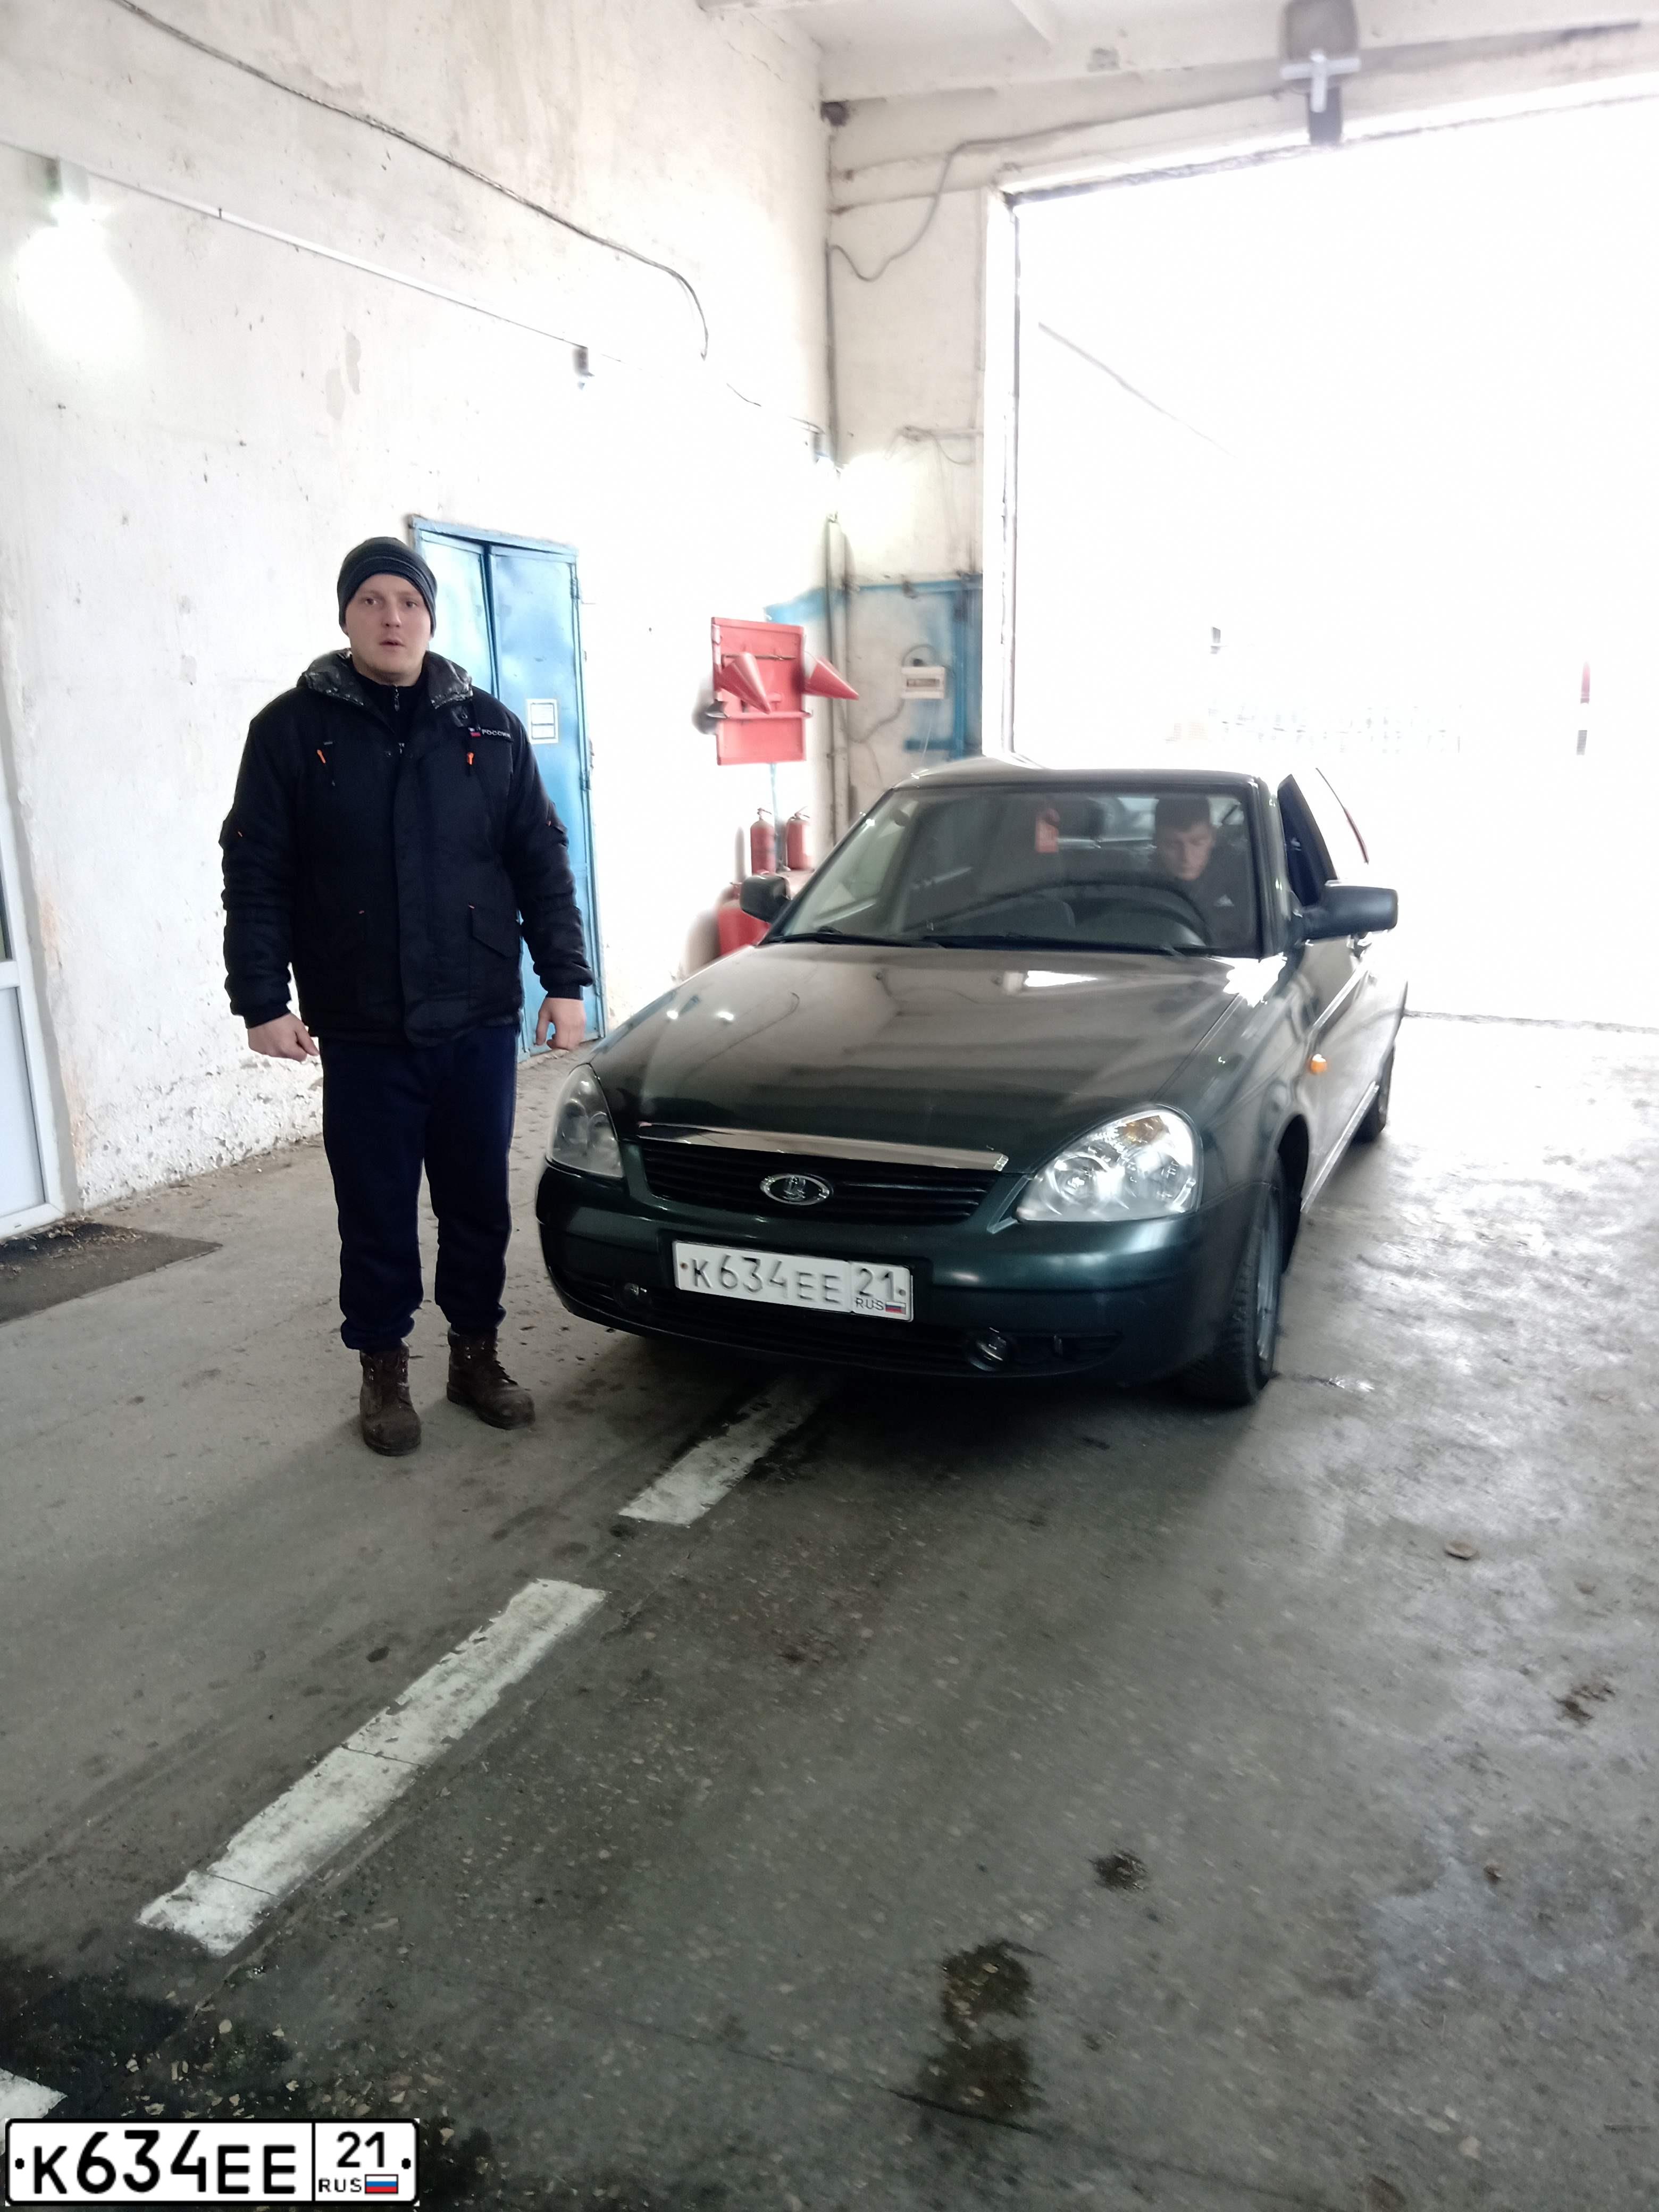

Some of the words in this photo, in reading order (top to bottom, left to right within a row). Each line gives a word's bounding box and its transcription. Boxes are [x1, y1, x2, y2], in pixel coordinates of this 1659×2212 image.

[691, 1254, 841, 1304] К634ЕЕ
[857, 1268, 894, 1301] 21
[855, 1297, 884, 1311] RUS
